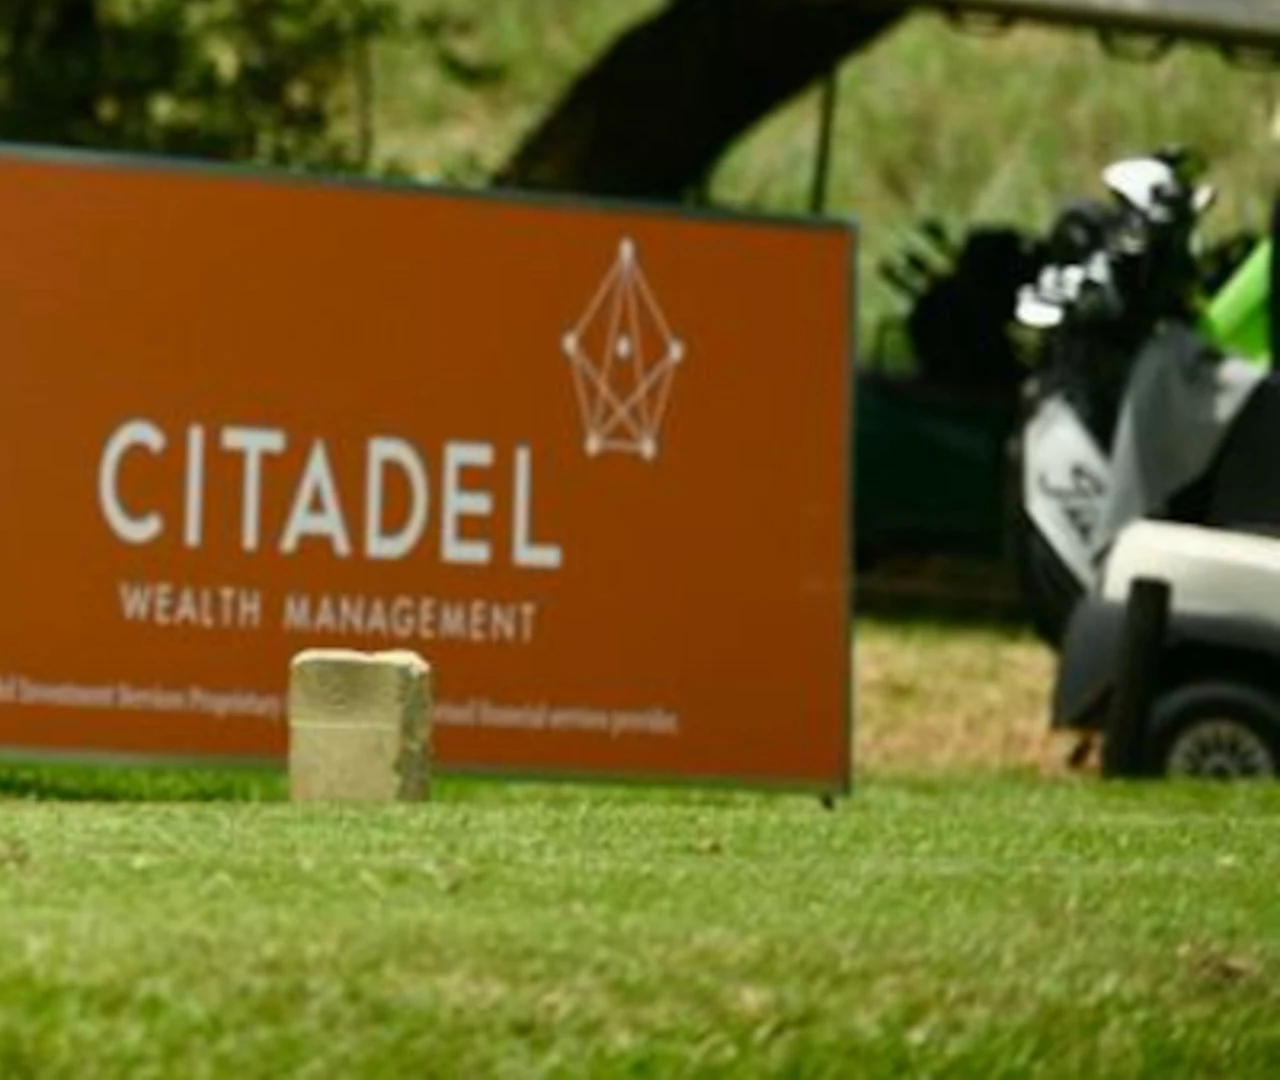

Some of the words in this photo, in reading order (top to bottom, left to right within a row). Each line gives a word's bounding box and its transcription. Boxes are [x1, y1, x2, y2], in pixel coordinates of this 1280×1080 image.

[98, 418, 563, 570] CITADEL
[119, 580, 262, 630] WEALTH
[282, 592, 537, 643] MANAGEMENT
